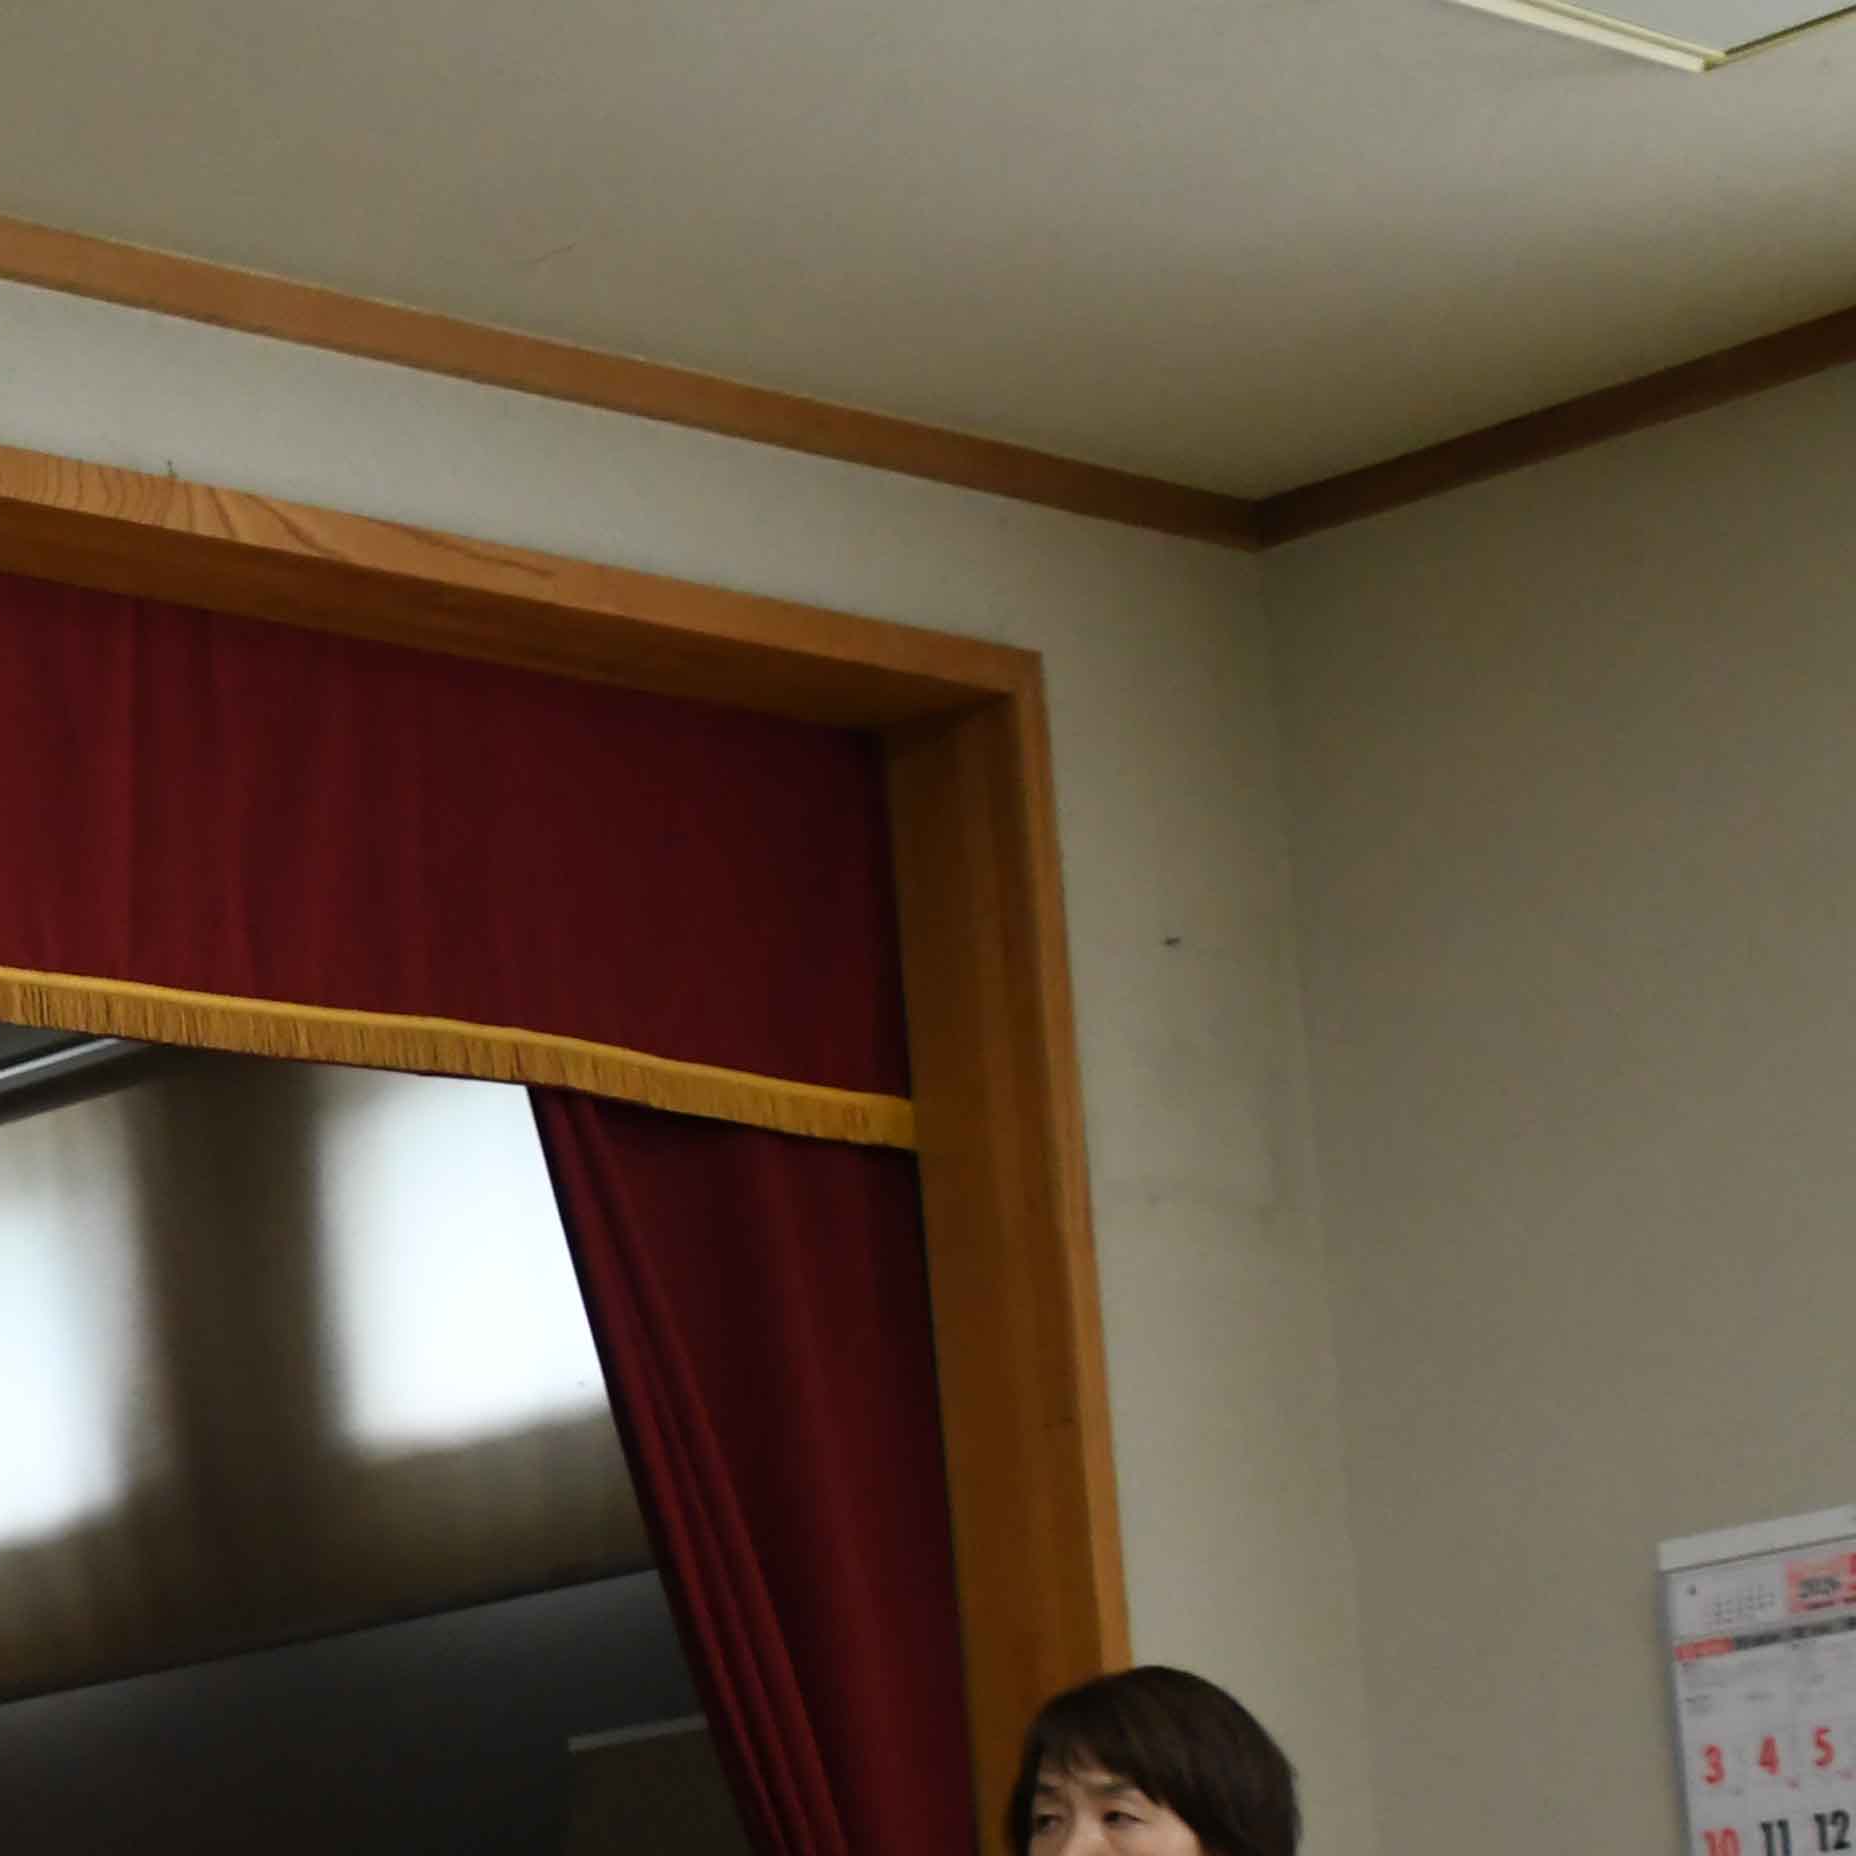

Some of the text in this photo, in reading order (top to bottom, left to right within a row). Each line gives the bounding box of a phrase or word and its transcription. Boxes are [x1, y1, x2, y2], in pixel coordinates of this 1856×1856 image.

[1702, 1744, 1726, 1786] 3
[1758, 1735, 1782, 1777] 4
[1812, 1727, 1836, 1770] 5
[1813, 1810, 1852, 1853] 12
